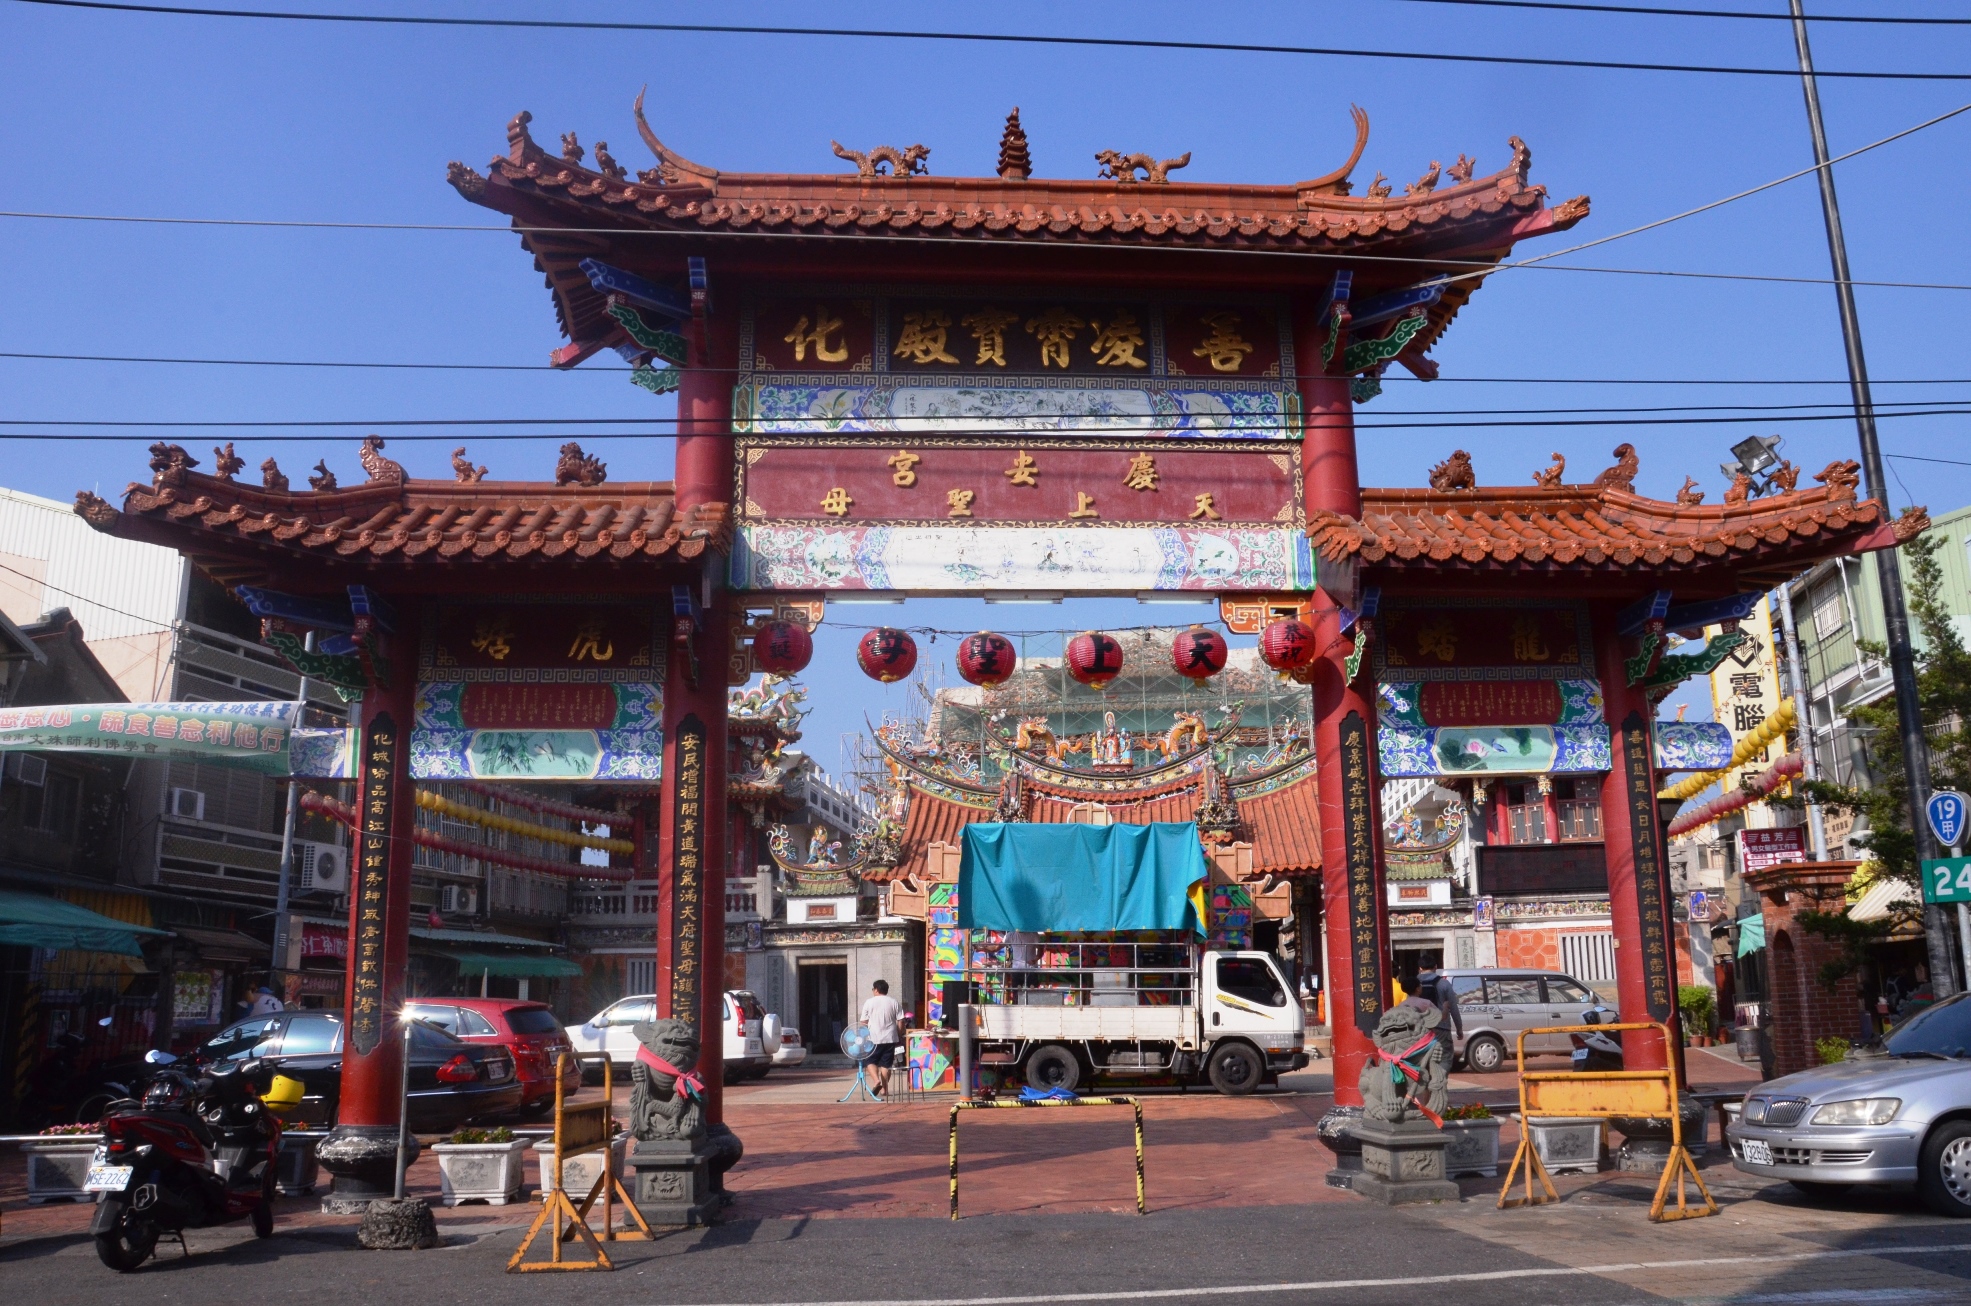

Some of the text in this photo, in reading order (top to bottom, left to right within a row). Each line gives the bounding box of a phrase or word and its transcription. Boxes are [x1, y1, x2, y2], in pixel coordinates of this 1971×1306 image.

[784, 307, 1253, 372] 善 凌霄寶殿 化
[887, 449, 1160, 491] 慶安宮
[820, 487, 1223, 519] 天上聖母
[870, 629, 909, 665] 母
[968, 637, 1006, 675] 聖
[1082, 634, 1119, 674] 上
[1187, 633, 1219, 672] 天
[1283, 621, 1308, 663] 恭祝
[28, 733, 159, 754] 文殊師利佛學會
[1936, 799, 1956, 820] 19
[1941, 820, 1954, 839] 甲
[1933, 863, 1971, 896] 24
[85, 1172, 130, 1185] MSE-2262
